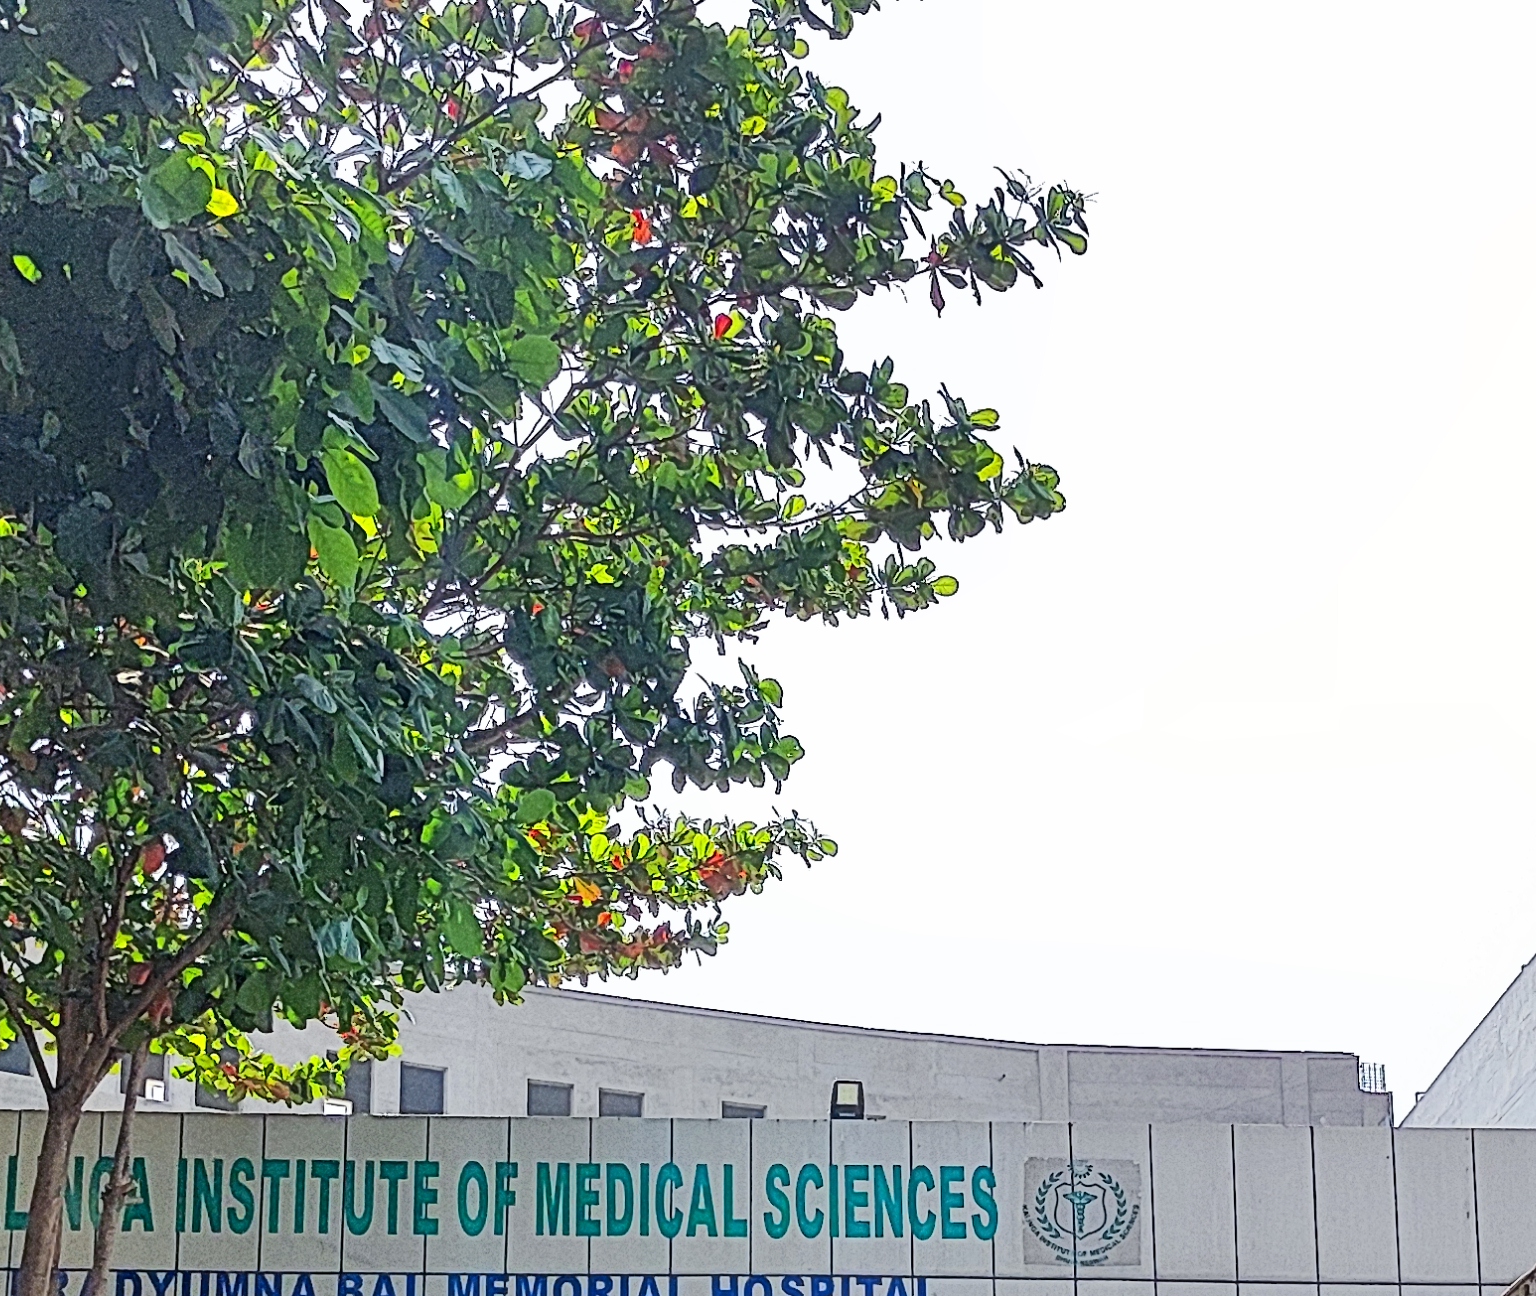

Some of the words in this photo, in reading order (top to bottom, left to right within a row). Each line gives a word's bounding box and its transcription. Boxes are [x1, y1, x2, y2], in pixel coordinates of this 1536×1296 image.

[176, 1157, 439, 1237] INSTITUTE
[457, 1159, 517, 1238] OF
[534, 1161, 748, 1239] MEDICAL
[763, 1162, 998, 1241] SCIENCES
